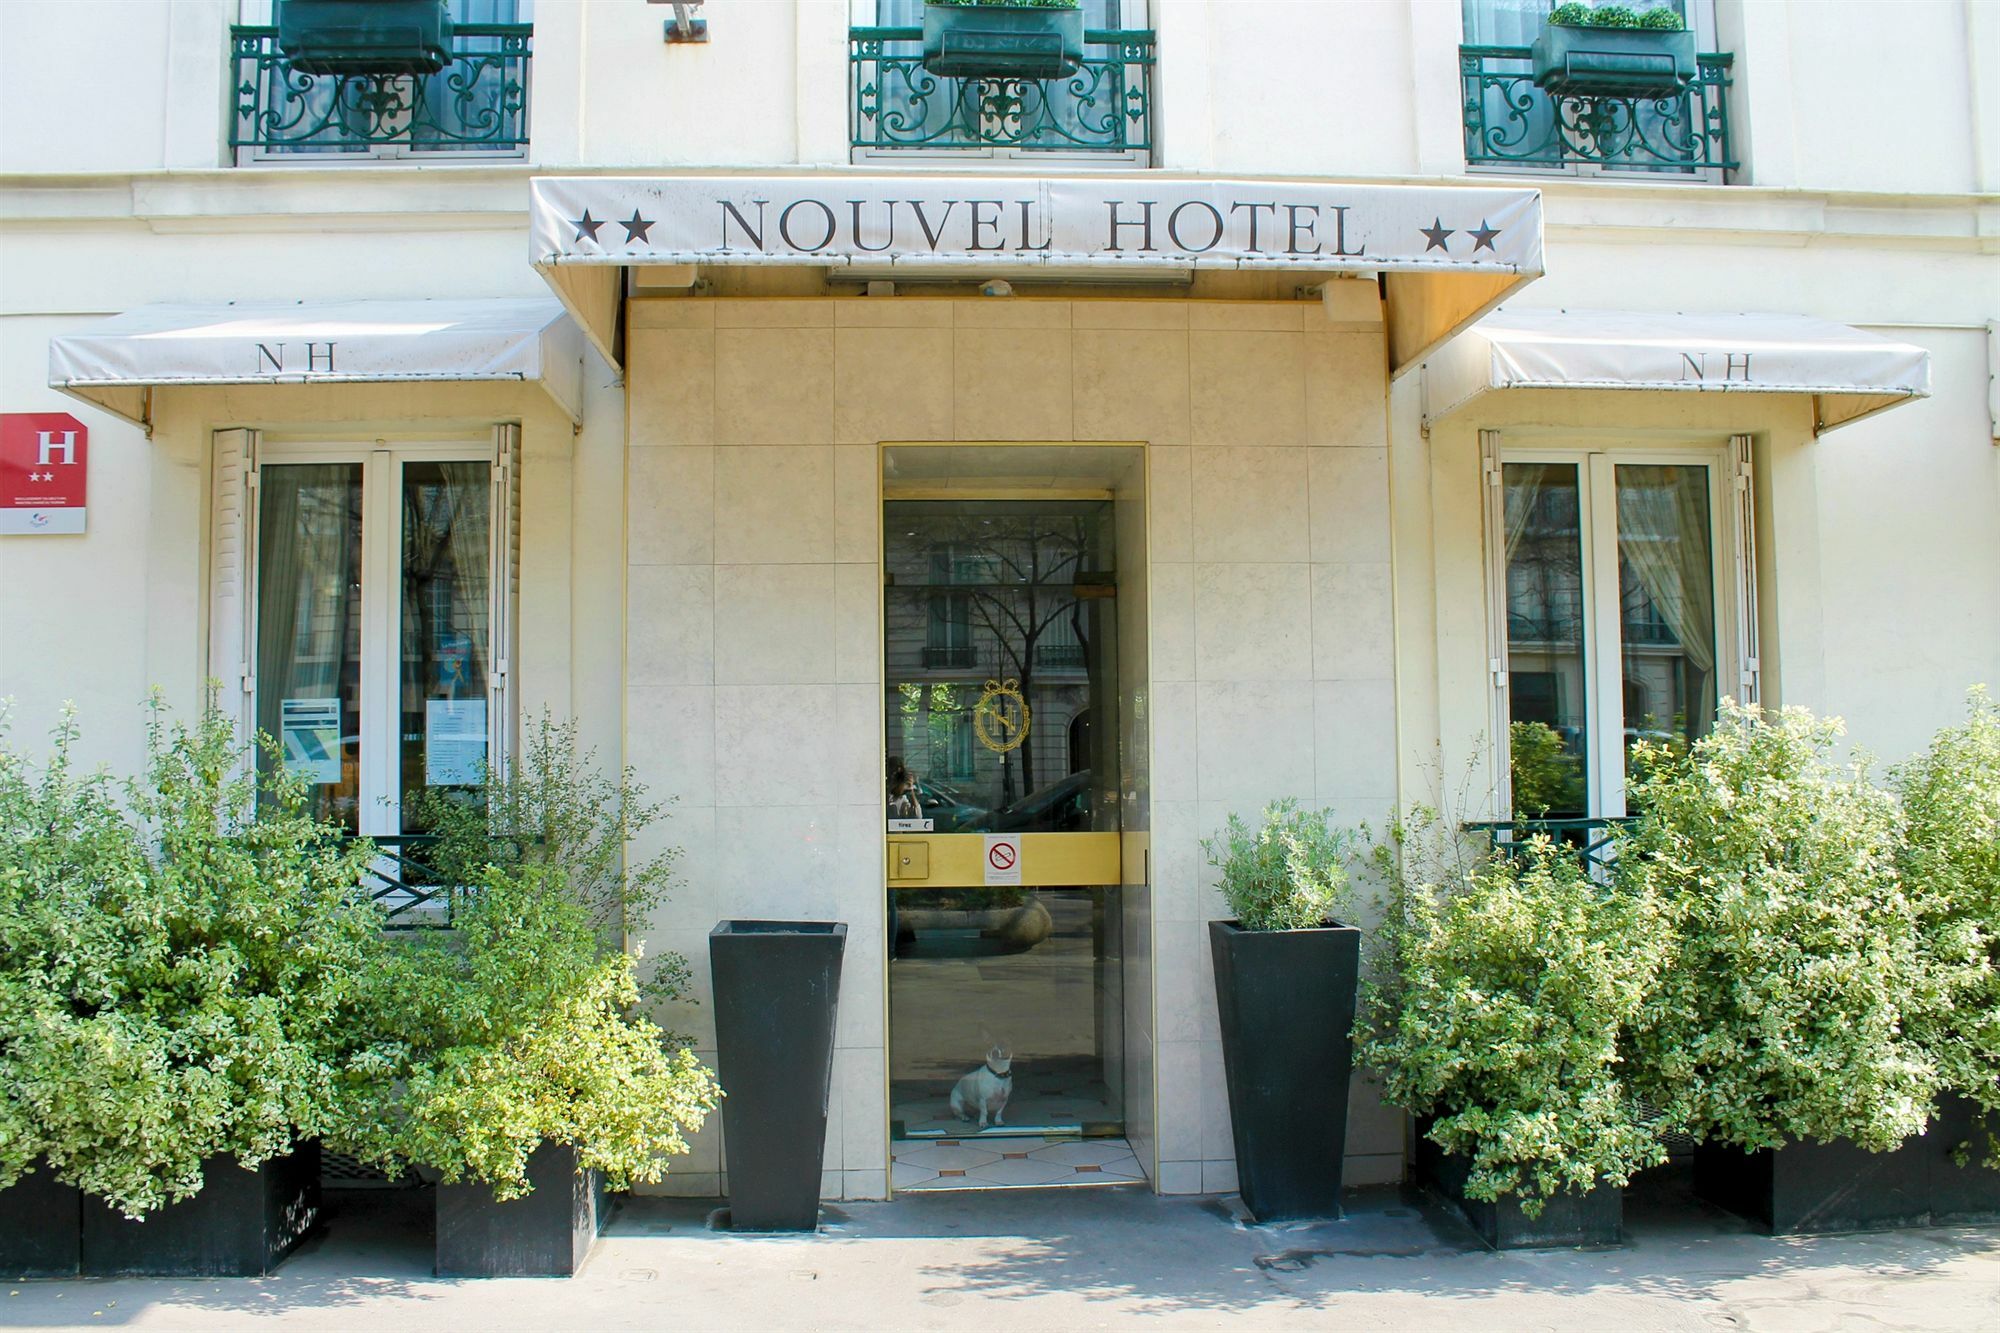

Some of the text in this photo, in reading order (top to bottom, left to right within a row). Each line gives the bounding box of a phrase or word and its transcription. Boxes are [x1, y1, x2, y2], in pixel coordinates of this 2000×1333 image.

[716, 199, 1366, 256] NOUVEL HOTEL
[35, 430, 79, 465] H
